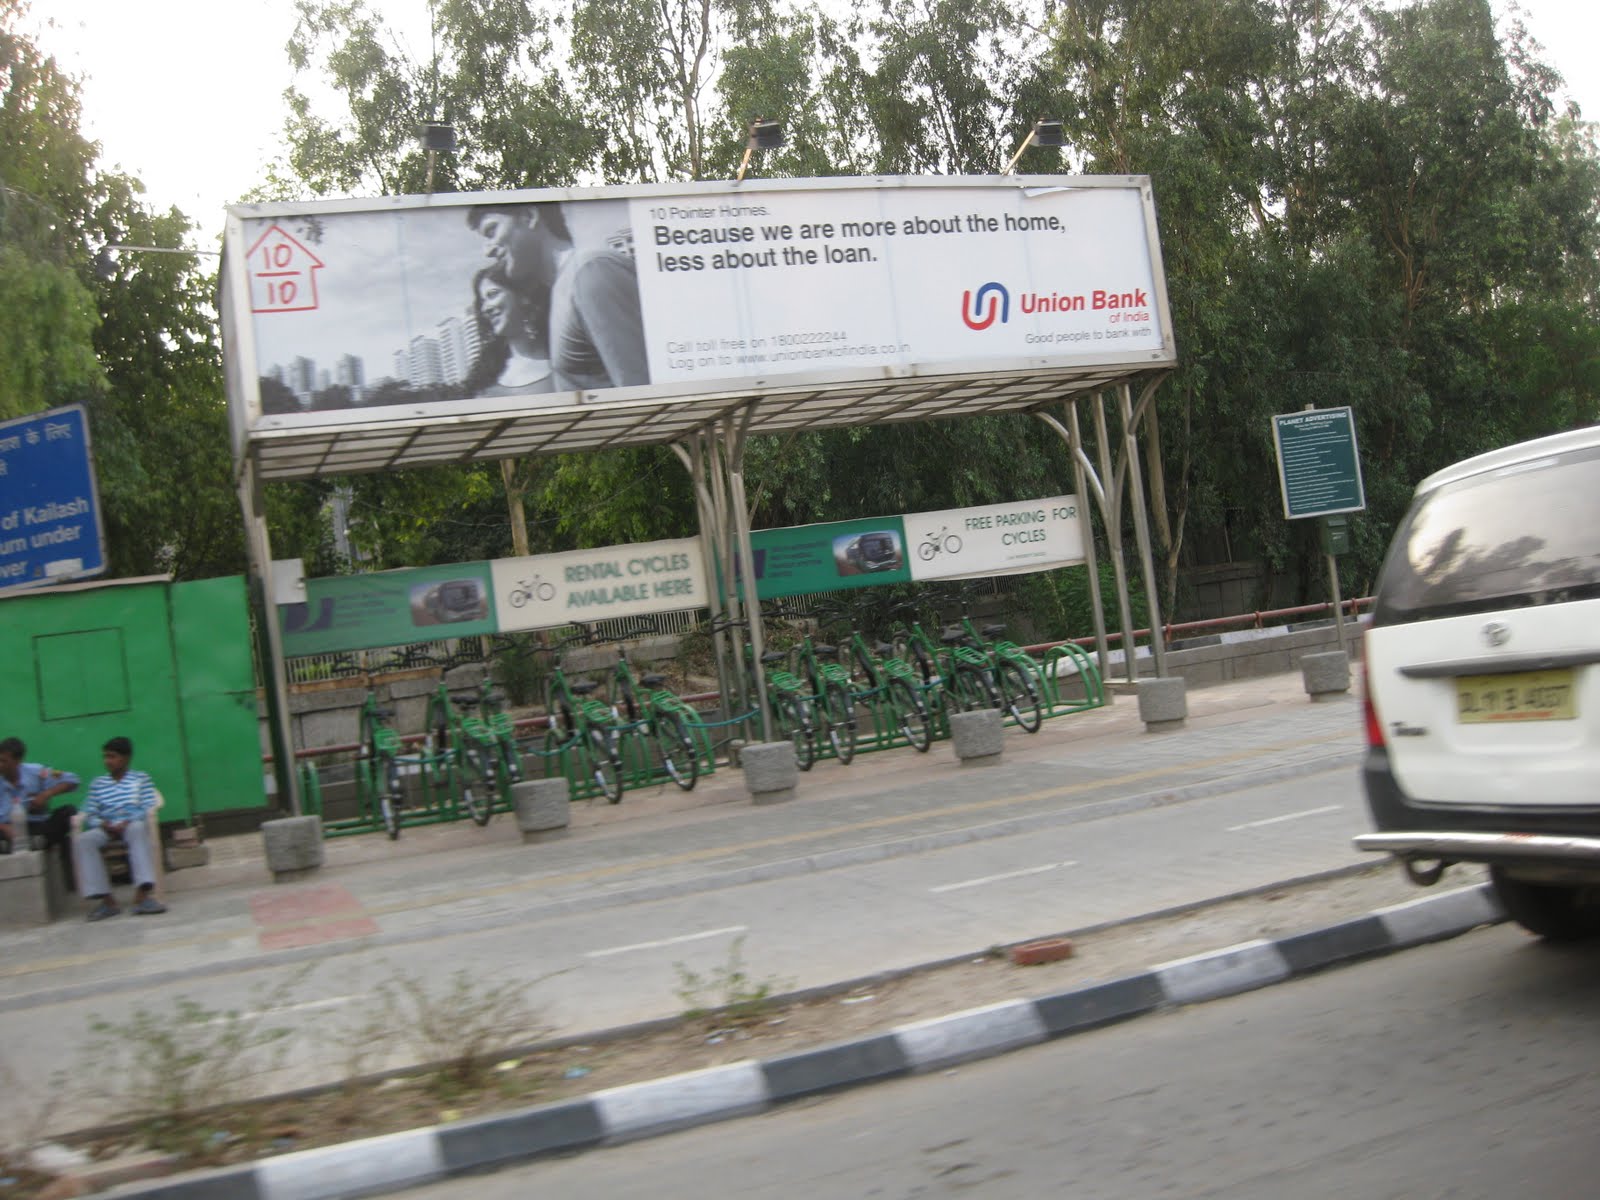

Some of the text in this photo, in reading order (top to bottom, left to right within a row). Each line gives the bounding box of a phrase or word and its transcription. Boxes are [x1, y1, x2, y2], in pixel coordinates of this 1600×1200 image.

[650, 204, 770, 220] 10 Pointer Homes.
[654, 212, 1066, 246] Because we are more about the home,
[263, 243, 292, 270] 10
[656, 243, 878, 272] less about the loan.
[267, 280, 298, 305] 10
[1020, 288, 1148, 314] Union Bank
[1109, 310, 1150, 324] of India
[667, 340, 692, 354] Call
[696, 339, 717, 352] toll
[720, 338, 747, 350] free
[750, 337, 767, 349] on
[1025, 331, 1053, 344] Good
[1055, 330, 1091, 344] people
[1093, 330, 1102, 340] to
[1105, 327, 1130, 340] bank
[668, 357, 695, 371] Log
[698, 356, 716, 367] on
[719, 354, 733, 366] to
[2, 498, 90, 531] of Kailash
[965, 506, 1077, 531] FREE PARKING FOR
[0, 525, 82, 555] urn under
[1001, 529, 1047, 546] CYCLES
[564, 553, 689, 583] RENTAL CYCLES
[566, 577, 694, 609] AVAILABLE HERE
